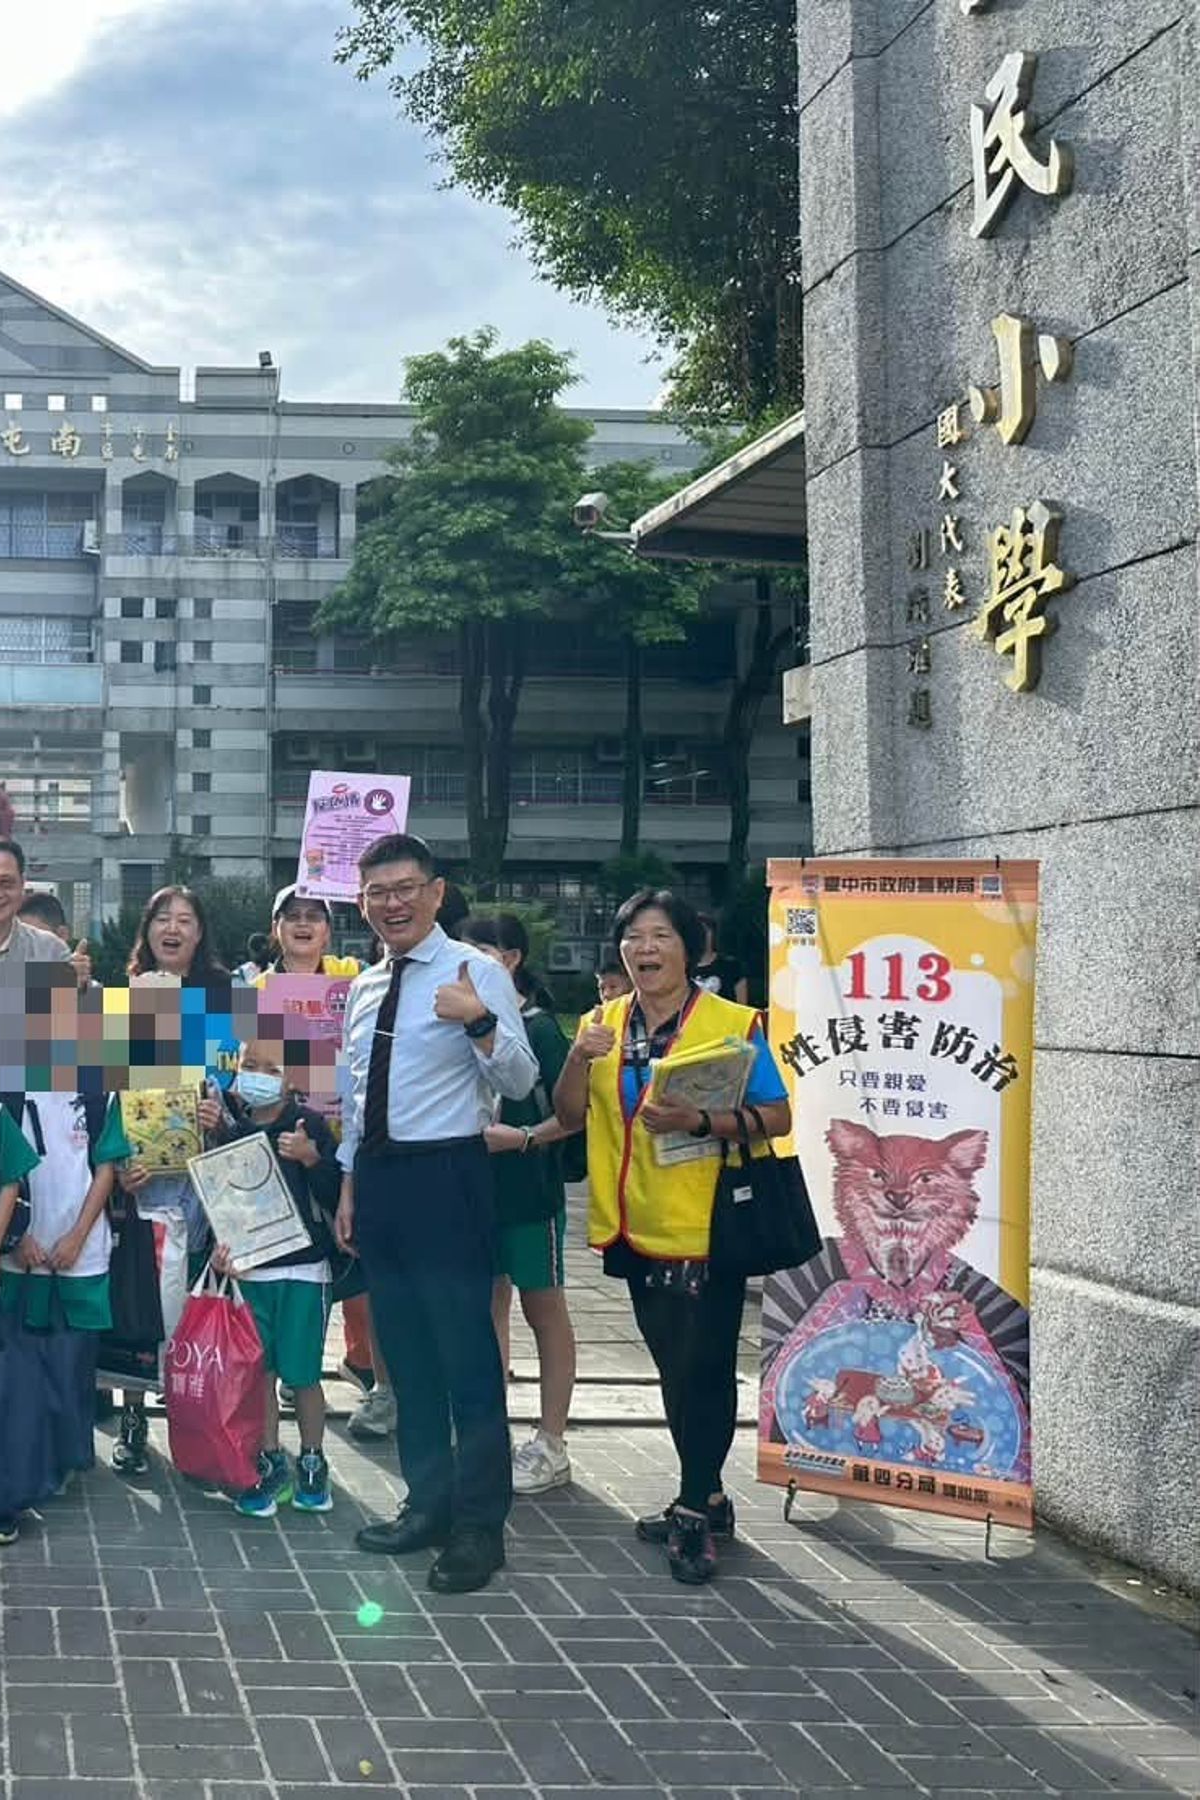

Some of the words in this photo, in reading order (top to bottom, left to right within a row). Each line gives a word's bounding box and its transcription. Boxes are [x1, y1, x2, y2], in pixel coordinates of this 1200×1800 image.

[960, 0, 1070, 692] 民小學
[937, 404, 966, 610] 國大代表
[824, 876, 975, 893] 臺中市政府警察局
[843, 951, 953, 1002] 113
[780, 1010, 1018, 1093] 性侵害防治
[840, 1069, 927, 1093] 只要親愛
[860, 1096, 948, 1120] 不要侵害
[853, 1464, 936, 1495] 第四分局
